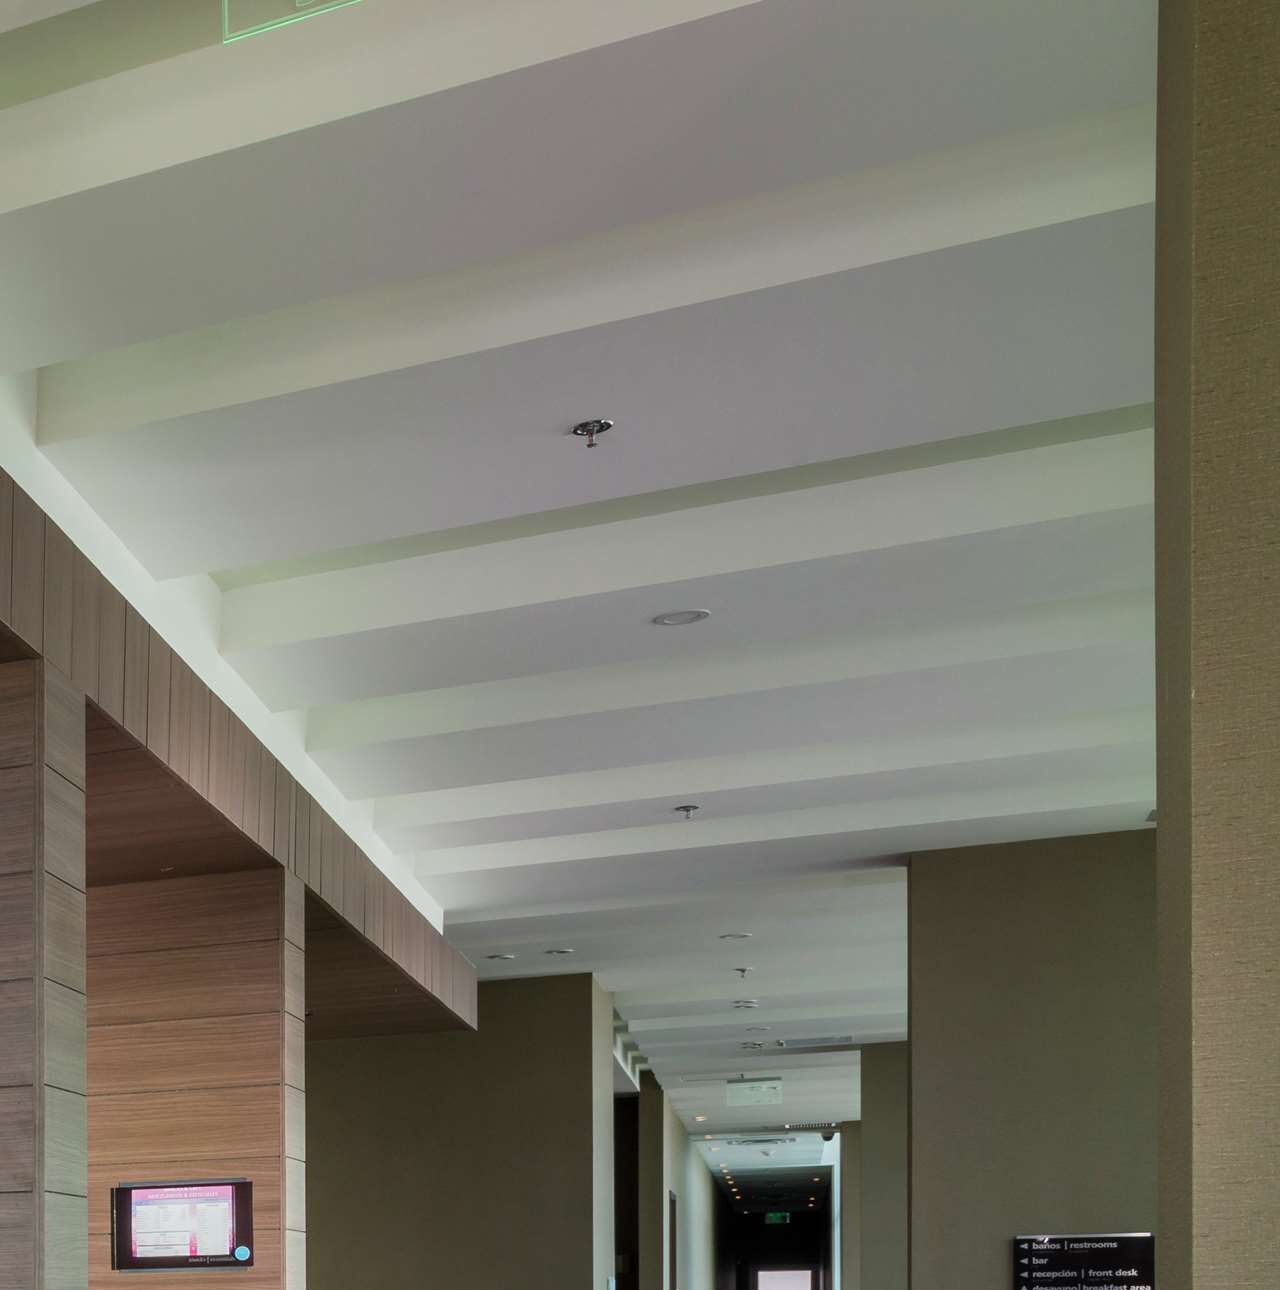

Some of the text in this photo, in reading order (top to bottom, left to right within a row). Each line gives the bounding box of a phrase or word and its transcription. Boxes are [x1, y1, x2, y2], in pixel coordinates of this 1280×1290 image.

[1069, 1241, 1118, 1249] restrooms
[1032, 1257, 1049, 1265] bar
[1032, 1268, 1139, 1279] recepción front desk
